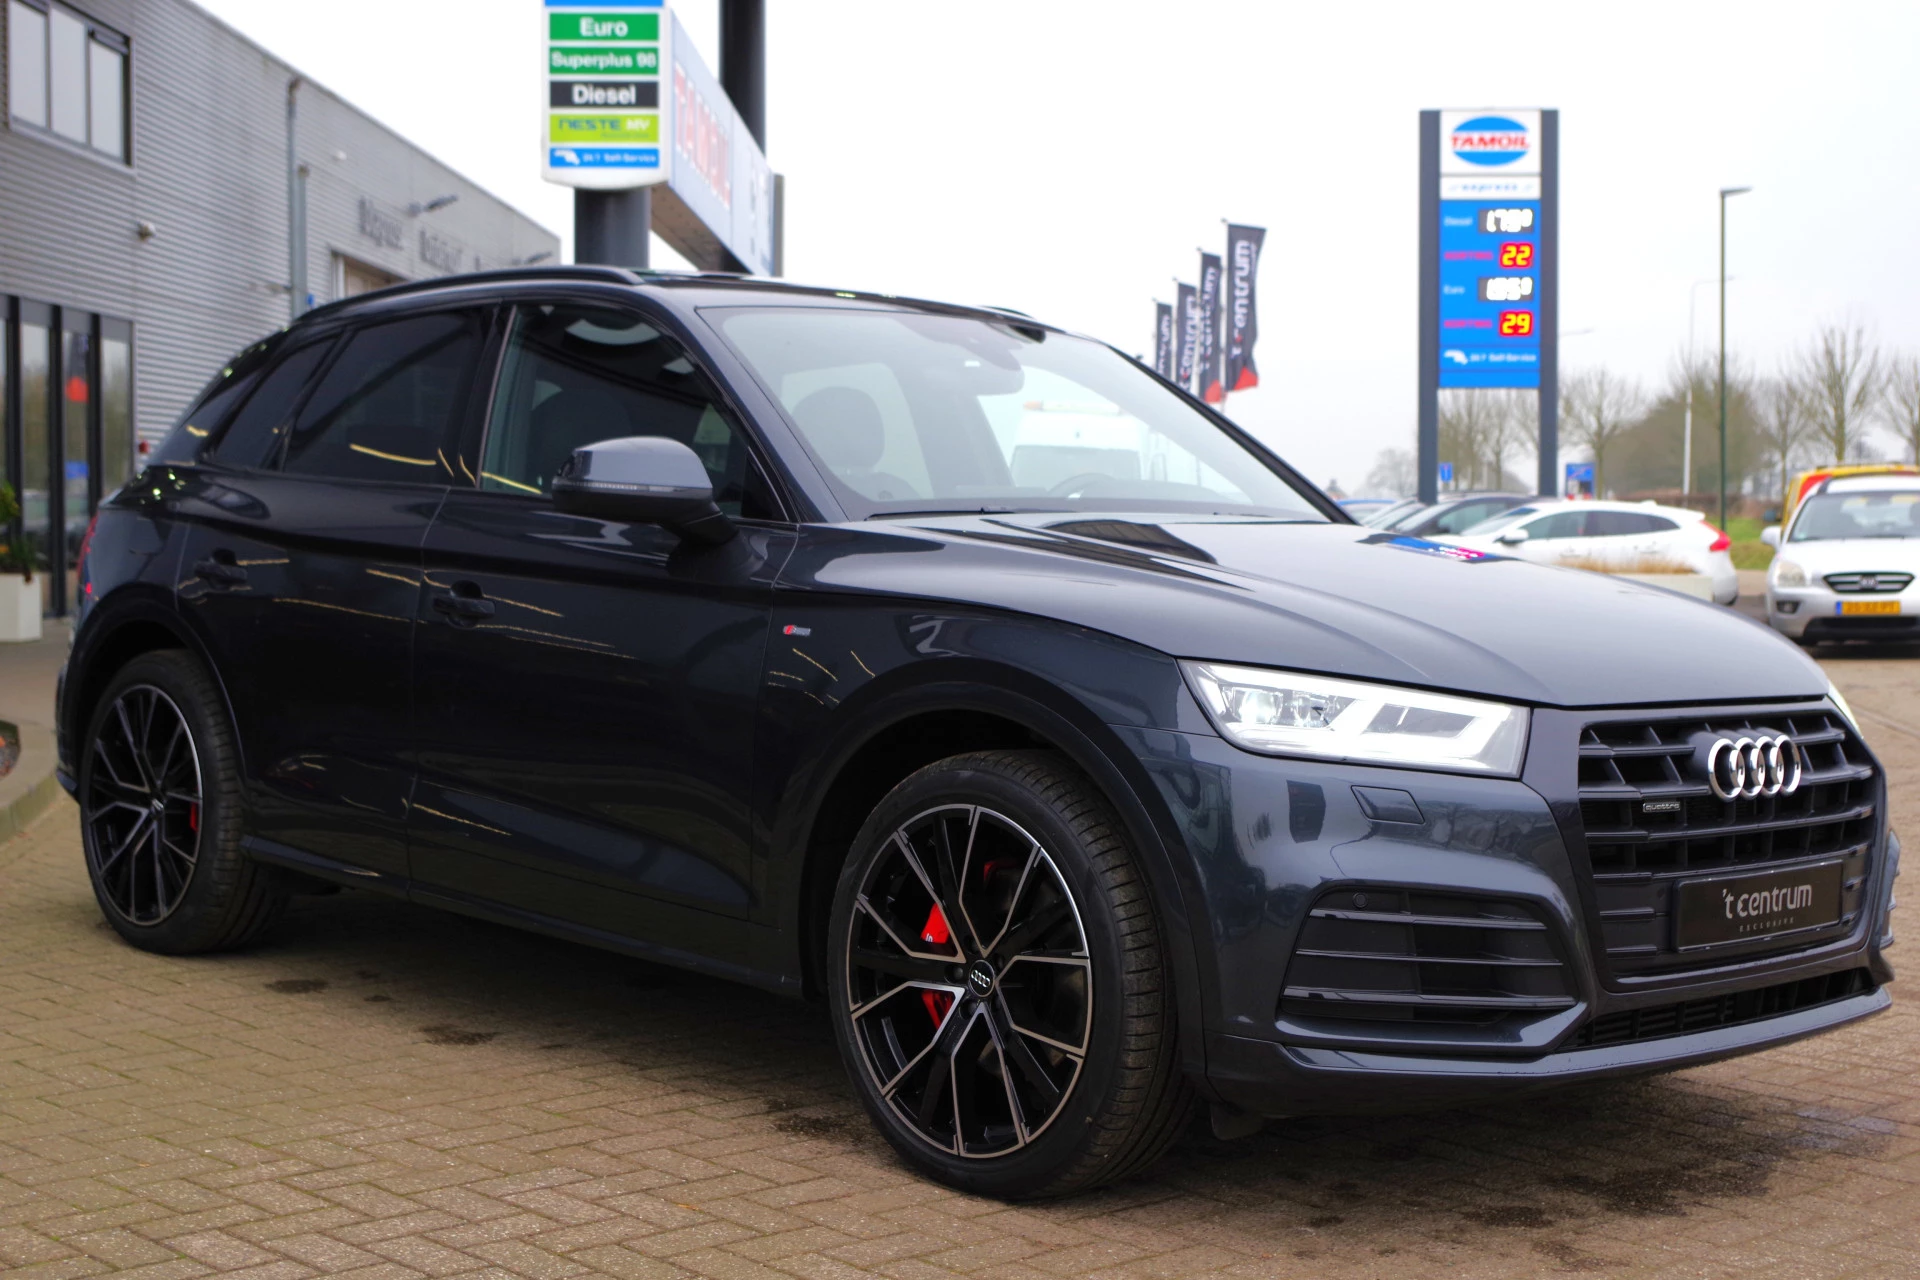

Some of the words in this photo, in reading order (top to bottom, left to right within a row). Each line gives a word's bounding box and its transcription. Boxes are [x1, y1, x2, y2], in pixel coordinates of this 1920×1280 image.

[579, 18, 629, 37] Euro
[551, 52, 632, 69] Superplus
[572, 85, 636, 104] Diesel
[1450, 134, 1530, 149] TAMOIL
[1501, 244, 1532, 267] 22
[1501, 313, 1531, 335] 29
[1737, 884, 1812, 917] centrum
